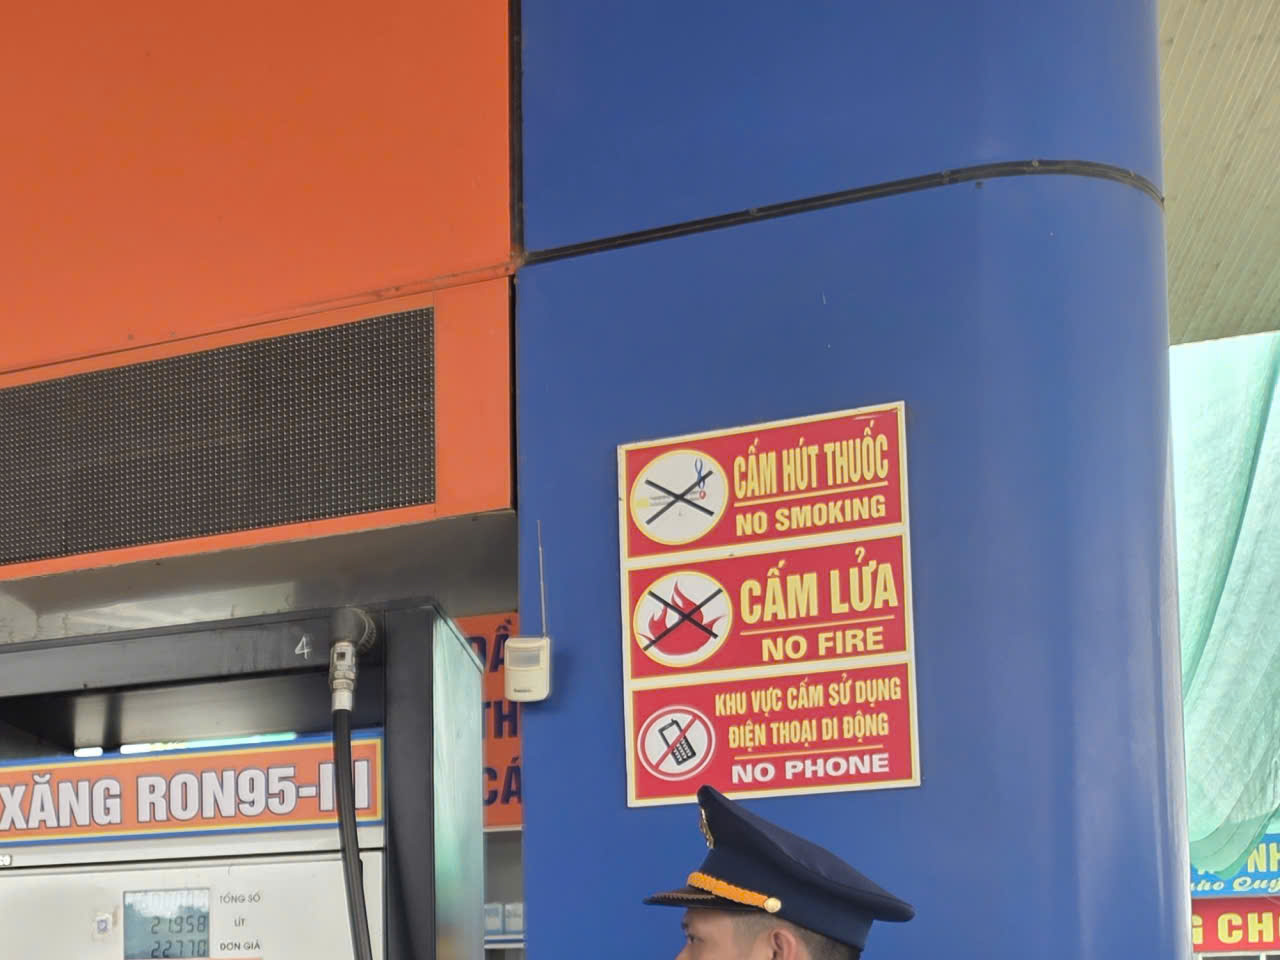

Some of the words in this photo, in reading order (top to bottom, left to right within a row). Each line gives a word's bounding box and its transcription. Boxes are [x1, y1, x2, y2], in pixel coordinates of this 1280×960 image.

[733, 437, 778, 499] CẤM
[782, 437, 819, 492] HÚT
[823, 419, 889, 486] THUỐC
[735, 511, 768, 536] NO
[775, 494, 886, 531] SMOKING
[740, 560, 819, 625] CẤM
[829, 546, 899, 614] LỬA
[294, 634, 312, 660] 4
[761, 635, 807, 661] NO
[818, 626, 884, 655] FIRE
[715, 692, 747, 717] KHU
[751, 686, 783, 717] VỰC
[787, 677, 824, 711] CẤM
[828, 672, 852, 706] SỬ
[855, 677, 902, 708] DỤNG
[728, 720, 767, 752] ĐIỆN
[770, 718, 817, 747] THOẠI
[822, 717, 838, 741] DI
[842, 710, 889, 743] ĐỘNG
[731, 762, 775, 784] NO
[785, 753, 889, 780] PHONE
[136, 759, 371, 823] RON95-II
[1217, 911, 1280, 945] CH
